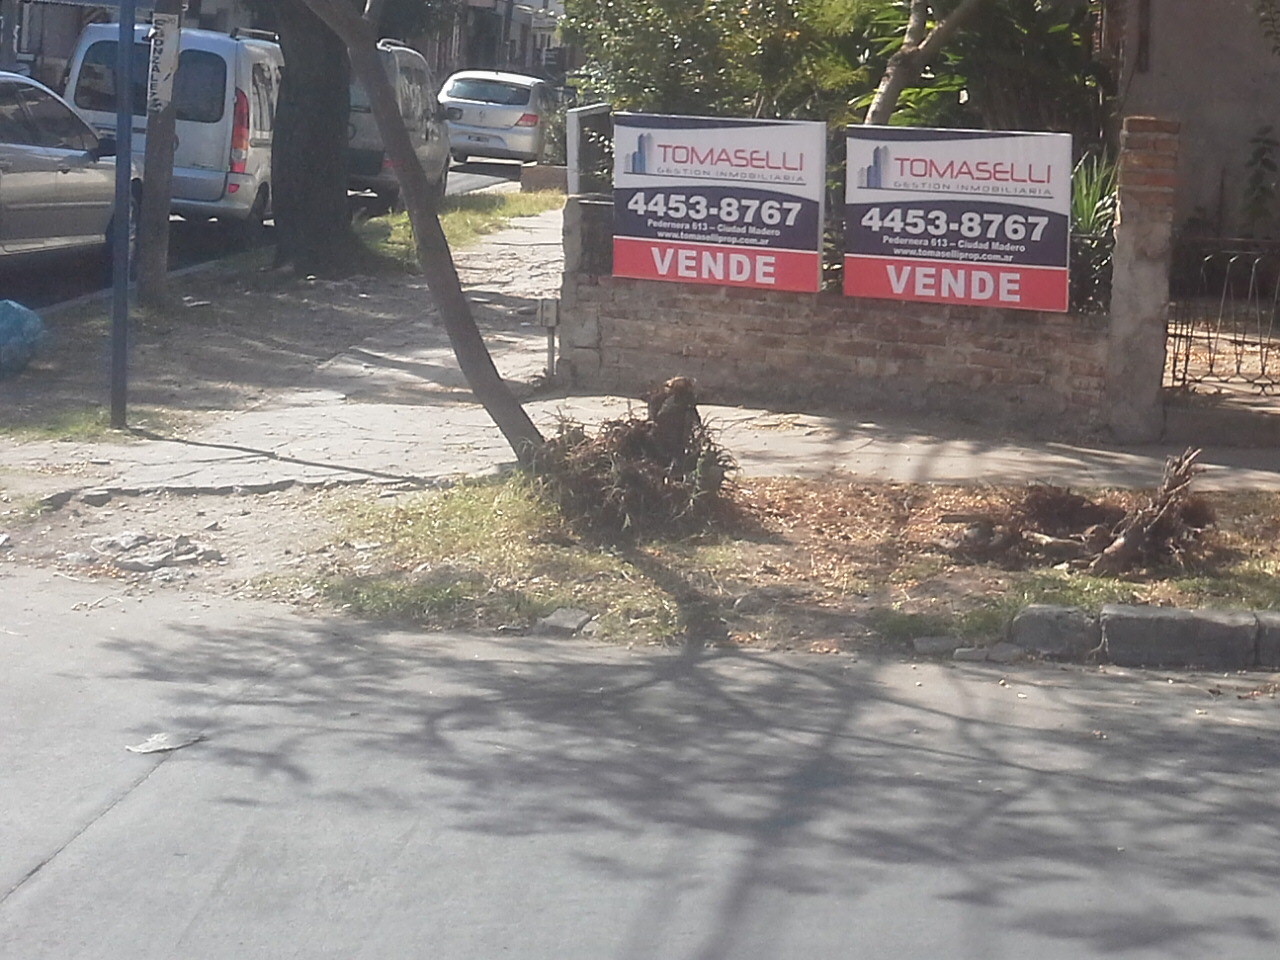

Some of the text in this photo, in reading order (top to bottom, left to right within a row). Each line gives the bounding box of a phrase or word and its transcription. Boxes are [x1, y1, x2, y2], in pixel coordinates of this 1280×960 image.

[657, 144, 804, 171] TOMASELLI
[656, 167, 804, 182] GESTION INMOBILIARIA
[894, 157, 1051, 184] TOMASELLI
[893, 181, 1051, 196] GESTION INMOBILIARIA
[628, 192, 801, 227] 4453-8767
[647, 219, 690, 231] Pedernera
[691, 221, 708, 231] 613
[717, 224, 746, 235] Ciudad
[748, 226, 780, 236] Madero
[861, 207, 1048, 242] 4453-8767
[657, 231, 769, 246] www.tomaselliprop.com.ar
[883, 235, 929, 247] Pedernera
[930, 238, 948, 248] 613
[958, 240, 989, 251] Ciudad
[991, 242, 1026, 253] Madero
[651, 247, 776, 285] VENDE
[893, 247, 1014, 263] www.tomaselliprop.com.ar
[886, 265, 1020, 302] VENDE
